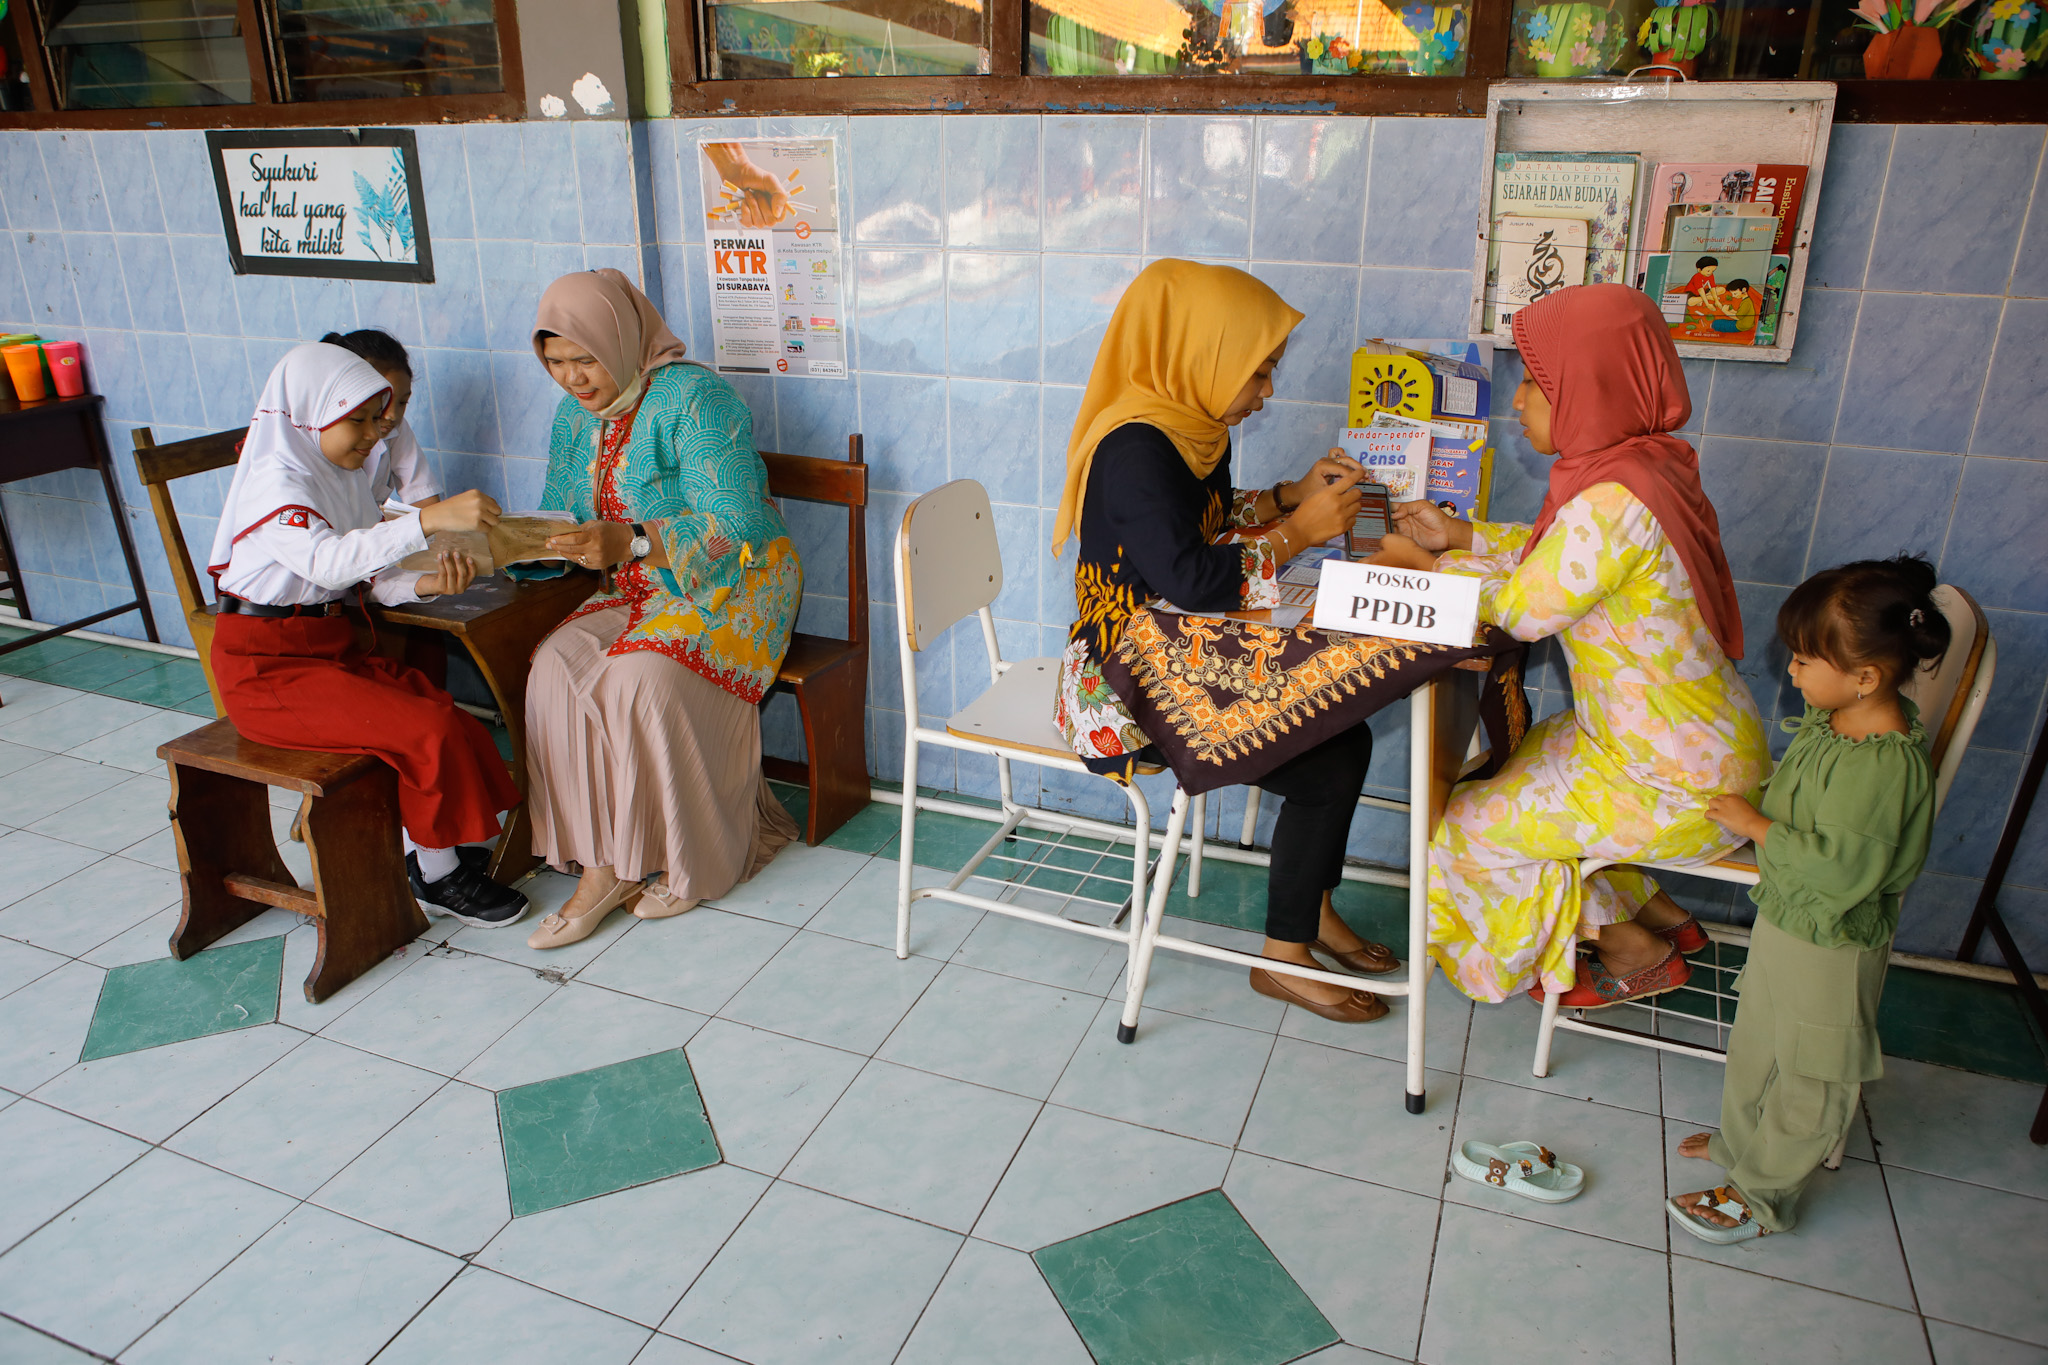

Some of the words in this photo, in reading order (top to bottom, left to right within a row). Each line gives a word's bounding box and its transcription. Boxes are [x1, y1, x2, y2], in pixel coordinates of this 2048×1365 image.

[250, 153, 318, 203] Syukuri
[1504, 173, 1620, 183] ENSIKLOPEDIA
[1503, 184, 1547, 199] SEJARAH
[1550, 186, 1572, 201] DAN
[1575, 186, 1618, 202] BUDAYA
[1755, 178, 1777, 203] SAI
[240, 192, 266, 218] hal
[272, 192, 298, 218] hal
[304, 204, 347, 240] yang
[260, 226, 292, 254] kita
[297, 227, 344, 255] miliki
[714, 239, 764, 249] PERWALI
[1693, 236, 1725, 244] Membuat
[715, 251, 767, 274] KTR
[1348, 431, 1425, 440] Pendar-pendar
[1369, 443, 1401, 451] Cerita
[1359, 452, 1406, 465] Pensa
[1366, 572, 1430, 591] POSKO
[1349, 596, 1436, 628] PPDB
